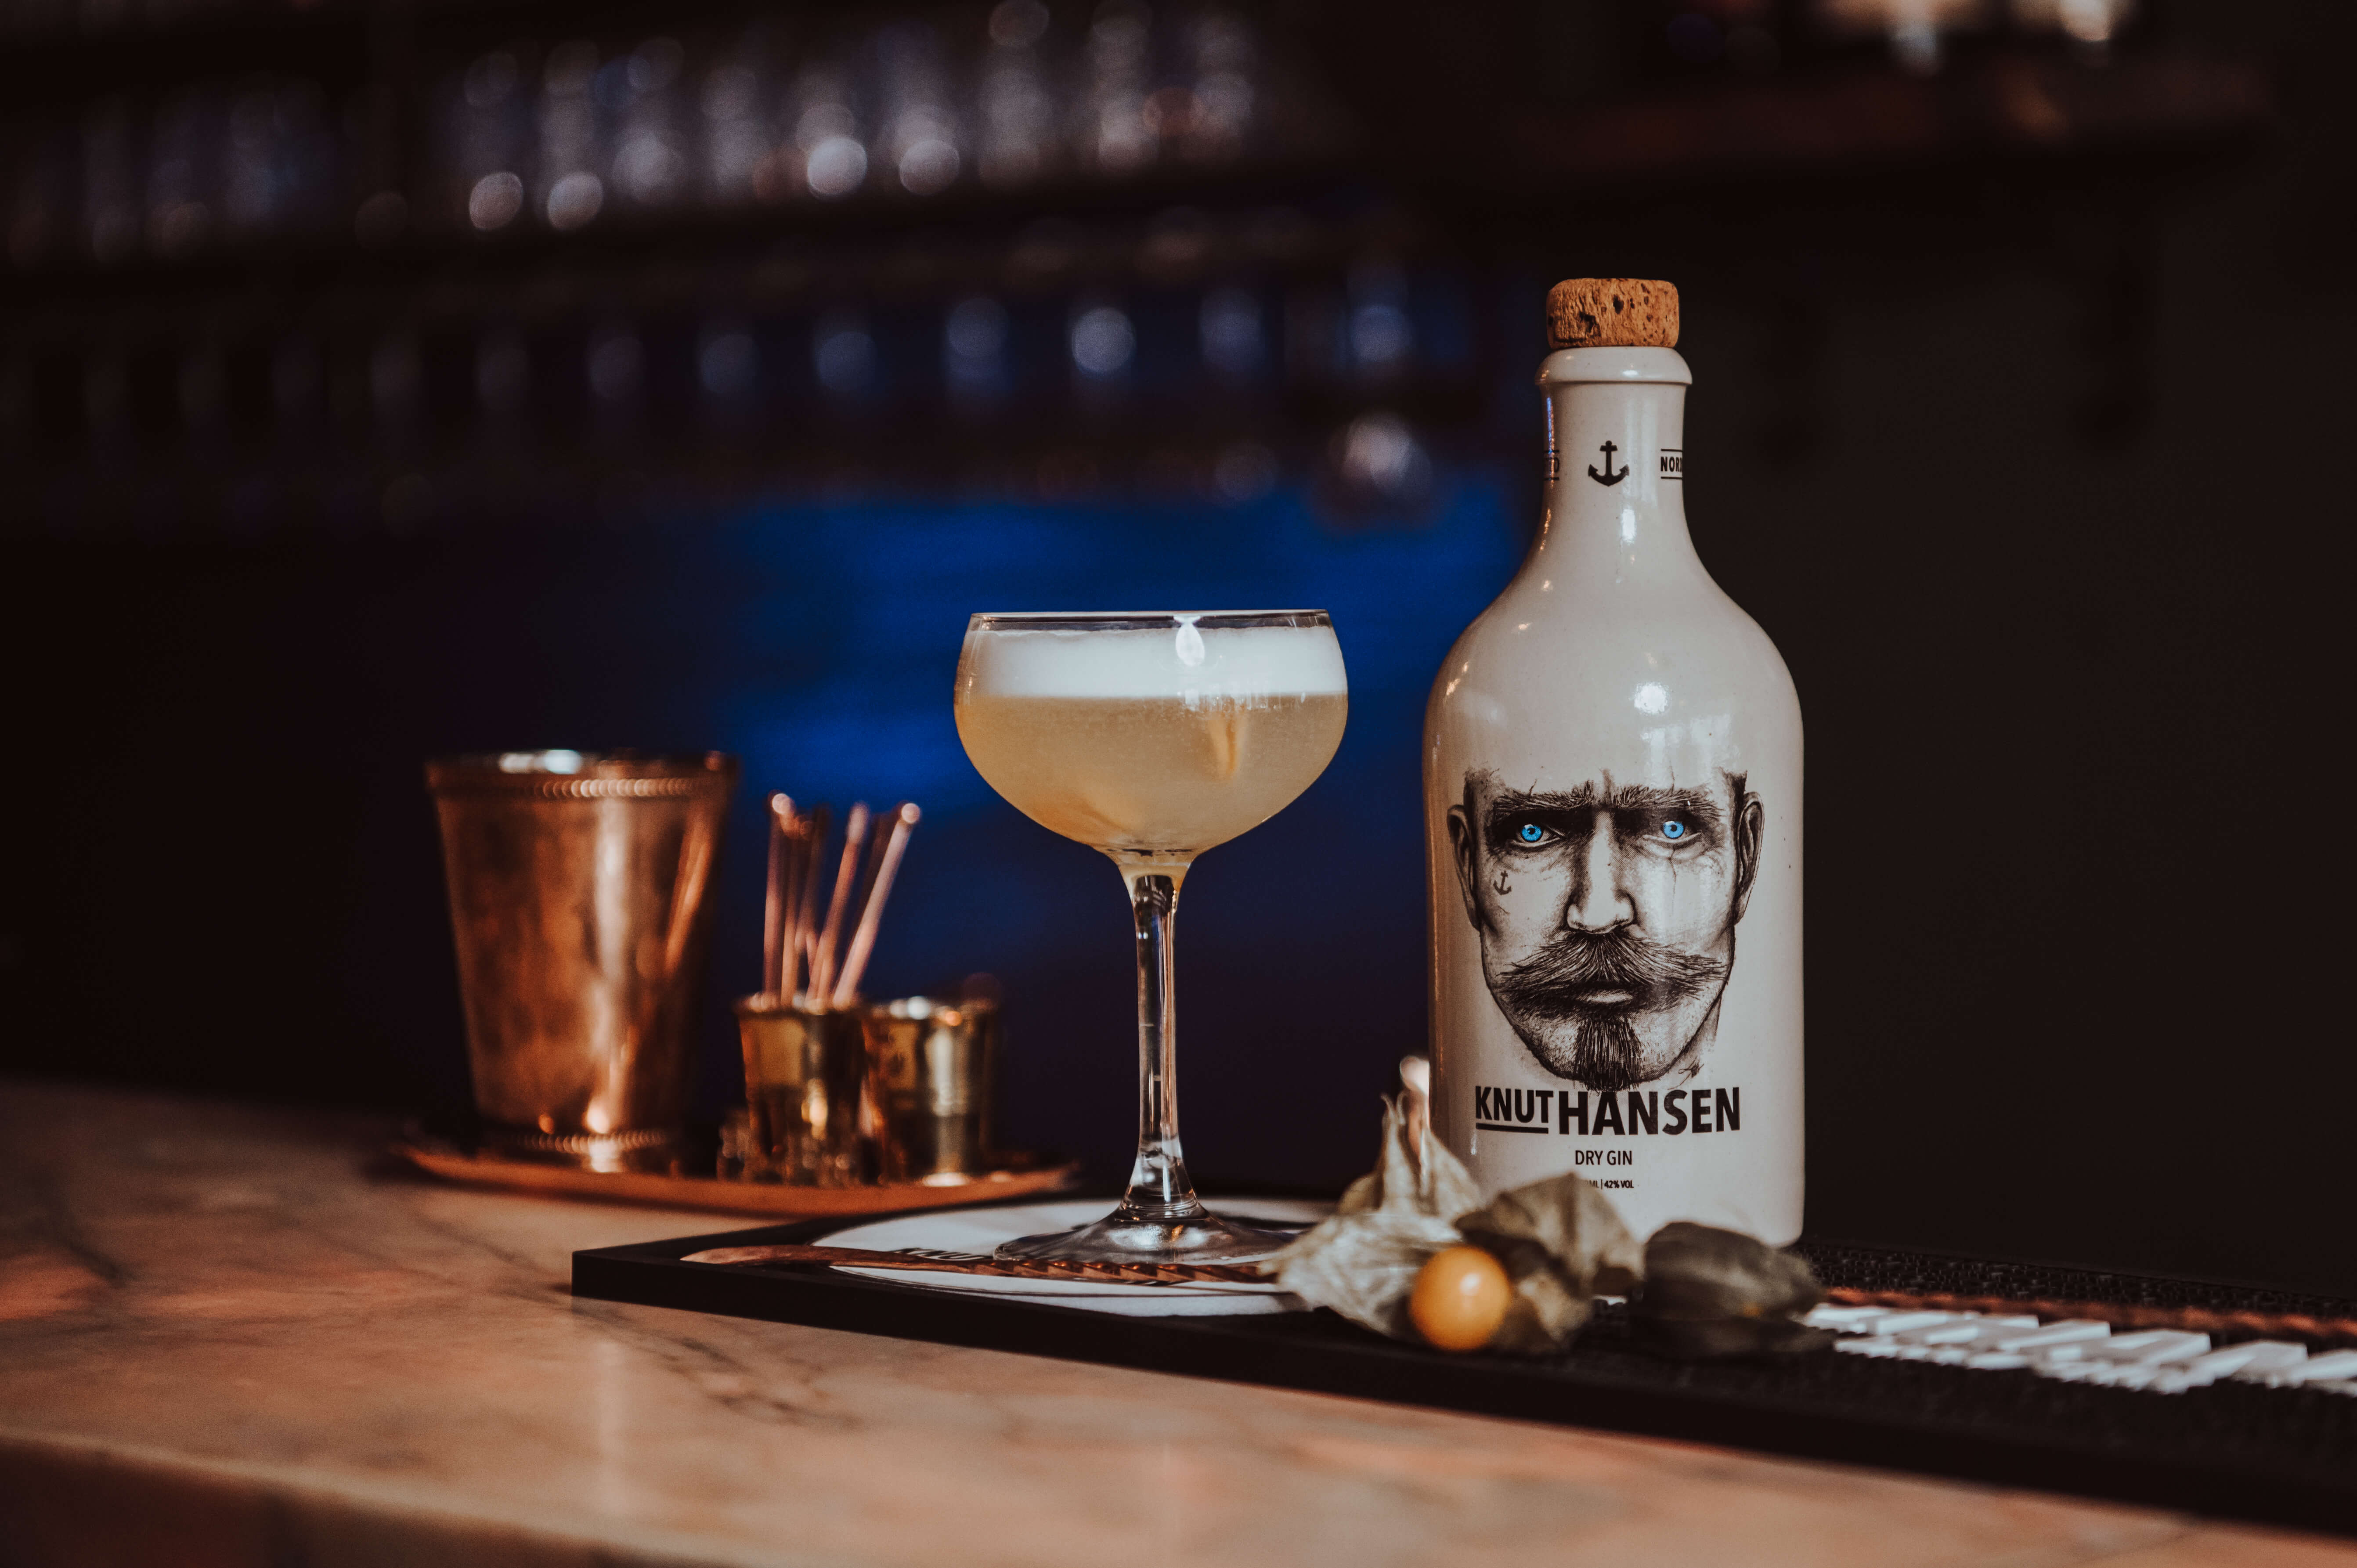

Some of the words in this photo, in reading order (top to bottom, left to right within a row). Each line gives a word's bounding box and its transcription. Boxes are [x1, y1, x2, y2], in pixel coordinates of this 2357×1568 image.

[1575, 1150, 1603, 1165] DRY
[1607, 1150, 1632, 1165] GIN
[1604, 1180, 1620, 1188] 42%
[1621, 1180, 1634, 1188] VOL
